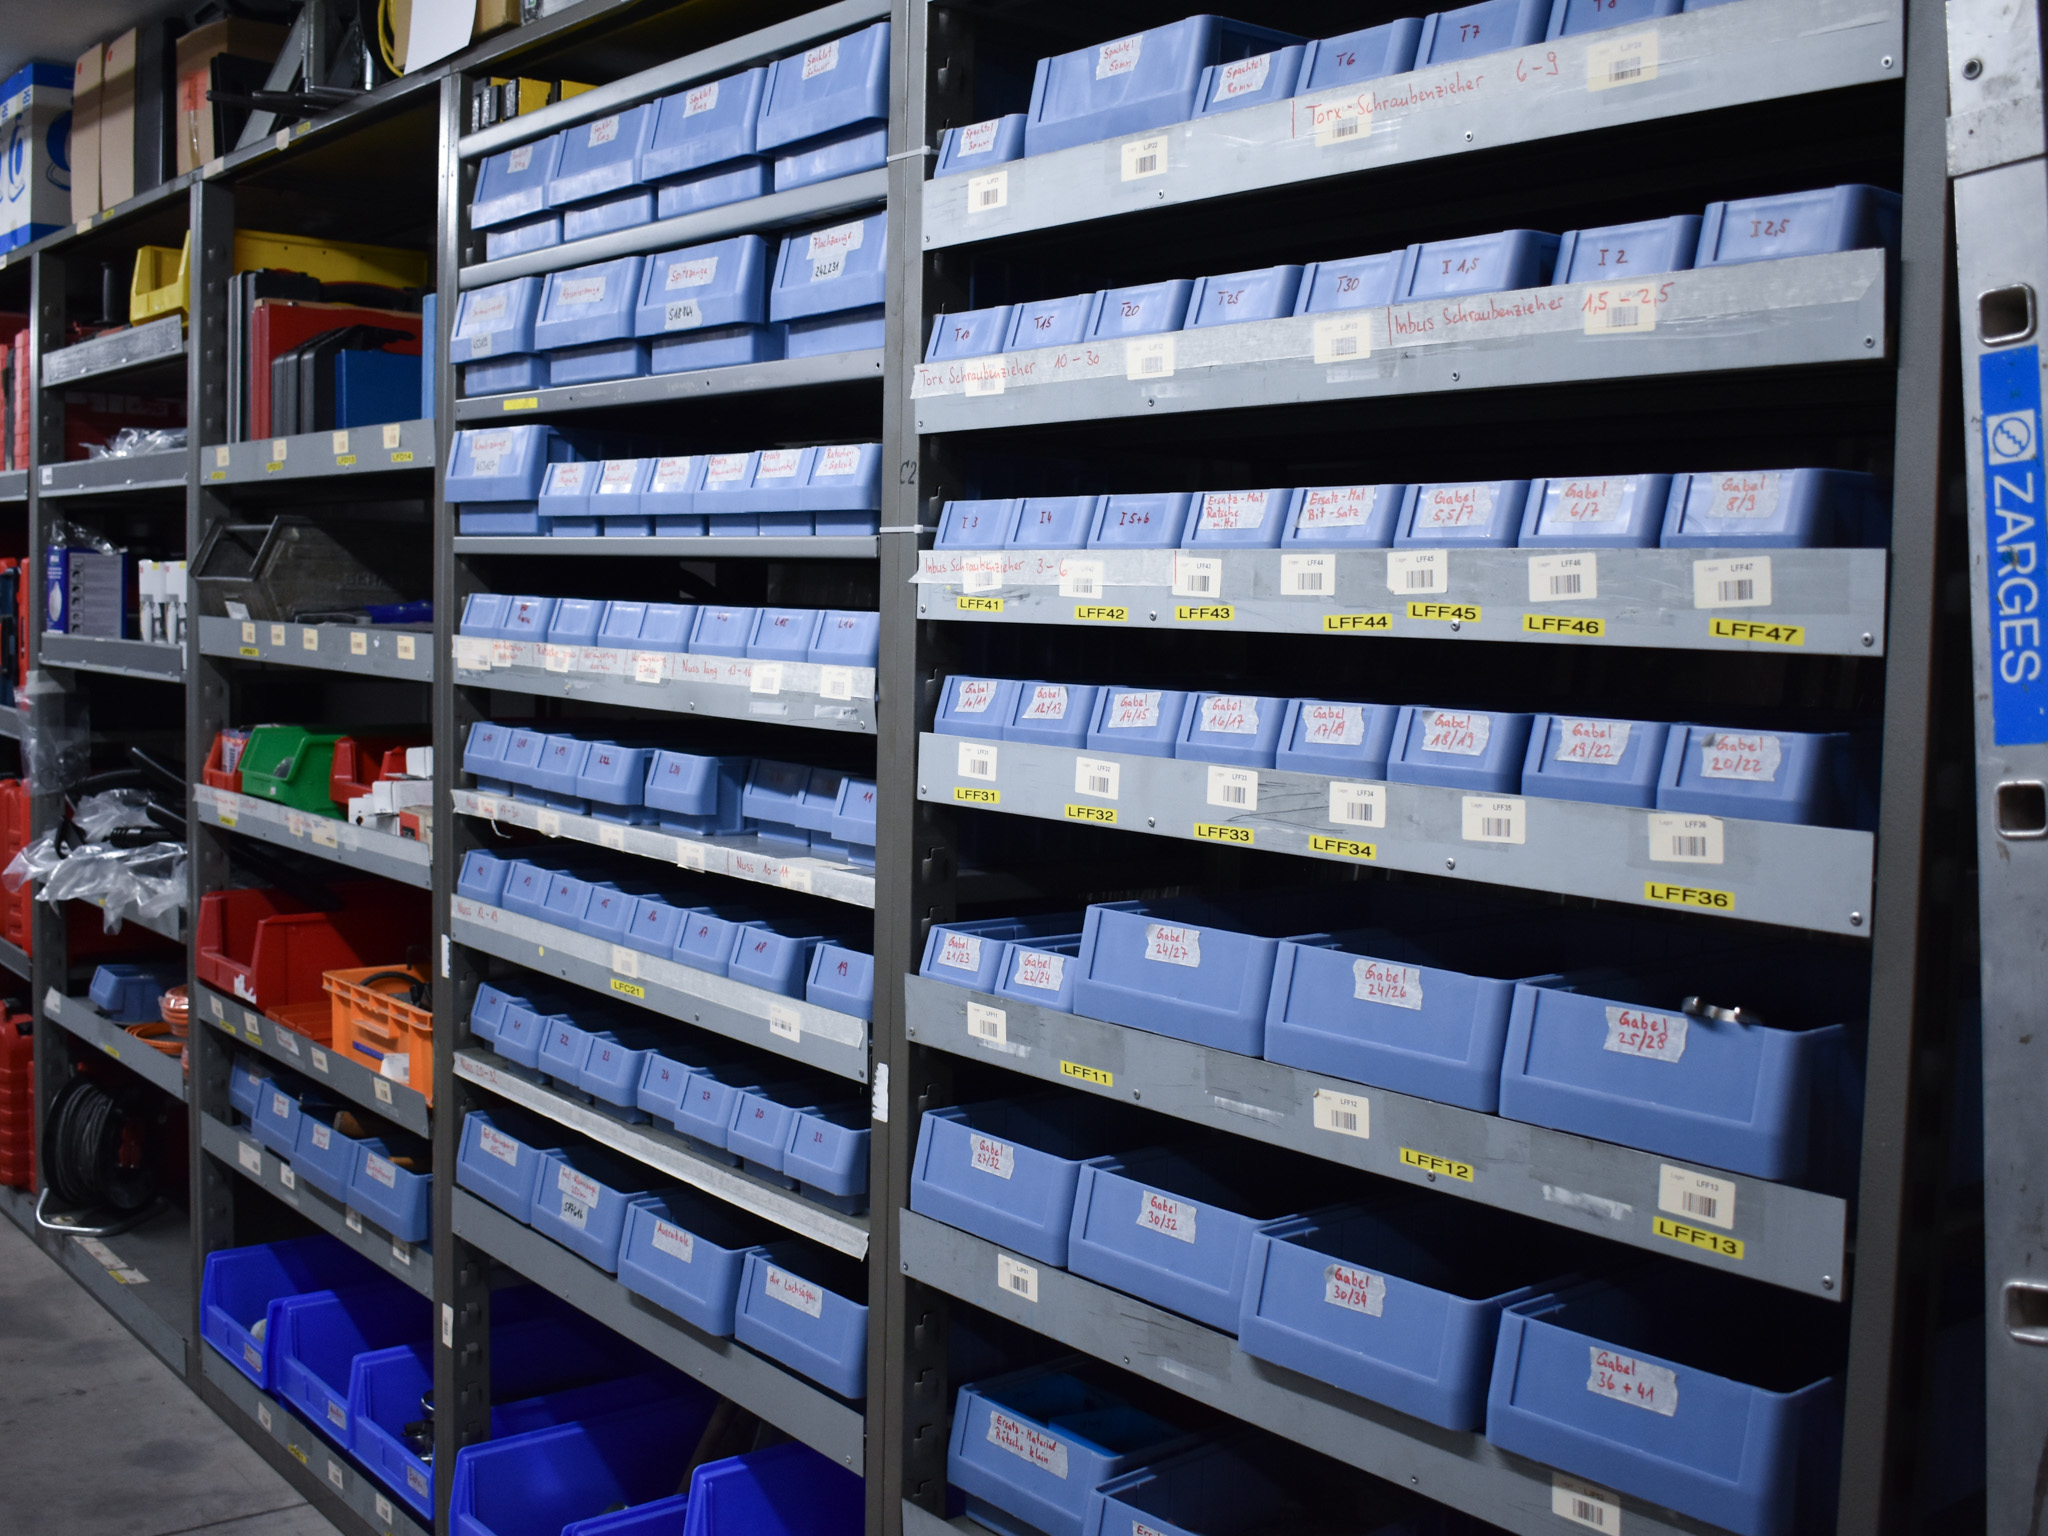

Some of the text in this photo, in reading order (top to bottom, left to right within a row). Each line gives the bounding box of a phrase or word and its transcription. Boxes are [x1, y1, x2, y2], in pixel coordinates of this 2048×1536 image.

[1460, 24, 1480, 42] T7
[1104, 40, 1135, 60] Spachtel
[1226, 58, 1263, 78] Spachtel
[1336, 52, 1356, 67] T6
[966, 121, 995, 140] Spachtel
[1618, 250, 1629, 264] 2
[815, 261, 840, 278] 242231
[1336, 276, 1360, 292] T30
[1120, 302, 1140, 317] T20
[1395, 312, 1434, 335] Inbus
[1443, 296, 1564, 326] Schraubenzieher
[1034, 316, 1055, 330] T15
[955, 328, 970, 342] T10
[920, 358, 1036, 386] Torx Schraubenzieher
[900, 462, 917, 485] C2
[1565, 480, 1606, 499] Gabel
[1720, 474, 1766, 495] Gabel
[1434, 488, 1477, 507] Gabel
[1726, 492, 1756, 512] 8/9
[1206, 507, 1240, 519] Ratsche
[1433, 503, 1475, 522] 5,5/7
[1571, 500, 1601, 518] 6/7
[1213, 517, 1238, 529] mittel
[926, 558, 947, 574] Inbus
[950, 556, 1025, 574] Schraubenzieher
[1561, 559, 1581, 568] LFF46
[1730, 563, 1753, 573] LFF47
[1994, 473, 2041, 684] ZARGES
[960, 599, 1000, 610] LFF41
[1078, 606, 1125, 620] LFF42
[1412, 604, 1476, 619] LFF45
[1179, 608, 1230, 619] LFF43
[1328, 616, 1388, 629] LFF44
[1529, 616, 1599, 634] LFF46
[1716, 622, 1798, 642] LFF47
[682, 660, 700, 673] Nuss
[704, 662, 718, 680] lang
[965, 682, 989, 695] Gabel
[1037, 688, 1062, 699] Gabel
[1034, 701, 1062, 715] 12/13
[1120, 694, 1149, 709] Gabel
[1212, 698, 1242, 712] Gabel
[1120, 707, 1150, 722] 14/15
[1210, 714, 1244, 729] 16/17
[1313, 706, 1345, 721] Gabel
[1435, 714, 1471, 729] Gabel
[1314, 720, 1345, 738] 17/19
[1572, 722, 1612, 739] Gabel
[1430, 730, 1474, 749] 18/19
[1715, 734, 1764, 754] Gabel
[1568, 740, 1611, 759] 19/22
[1712, 755, 1763, 773] 20/22
[864, 792, 873, 803] 11
[957, 790, 996, 802] LFF31
[1068, 806, 1114, 821] LFF32
[1685, 820, 1707, 829] LFF36
[1198, 825, 1250, 842] LFF33
[1314, 838, 1372, 857] LFF34
[737, 856, 755, 873] Nuss
[1651, 885, 1728, 907] LFF36
[948, 936, 969, 950] Gabel
[1157, 928, 1186, 943] Gabel
[754, 941, 767, 954] 18
[1156, 944, 1188, 960] 24/27
[946, 950, 970, 964] 21/23
[1024, 953, 1051, 968] Gabel
[837, 960, 849, 977] 19
[1024, 970, 1051, 984] 22/24
[1365, 964, 1407, 984] Gabel
[614, 980, 641, 996] LFC21
[1368, 983, 1407, 1000] 24/26
[1620, 1011, 1669, 1034] Gabel
[560, 1034, 569, 1047] 22
[1618, 1033, 1669, 1051] 25/28
[1064, 1064, 1107, 1084] LFF11
[1340, 1098, 1358, 1108] LFF12
[980, 1140, 1004, 1157] Gabel
[977, 1154, 1001, 1171] 27/32
[1406, 1151, 1469, 1179] LFF12
[1696, 1180, 1719, 1191] LFF13
[1150, 1196, 1178, 1215] Gabel
[1148, 1212, 1178, 1231] 30/32
[1660, 1221, 1736, 1254] LFF13
[1334, 1267, 1370, 1290] Gabel
[1596, 1352, 1636, 1375] Gabel
[1597, 1372, 1615, 1390] 36
[1638, 1385, 1654, 1402] 41
